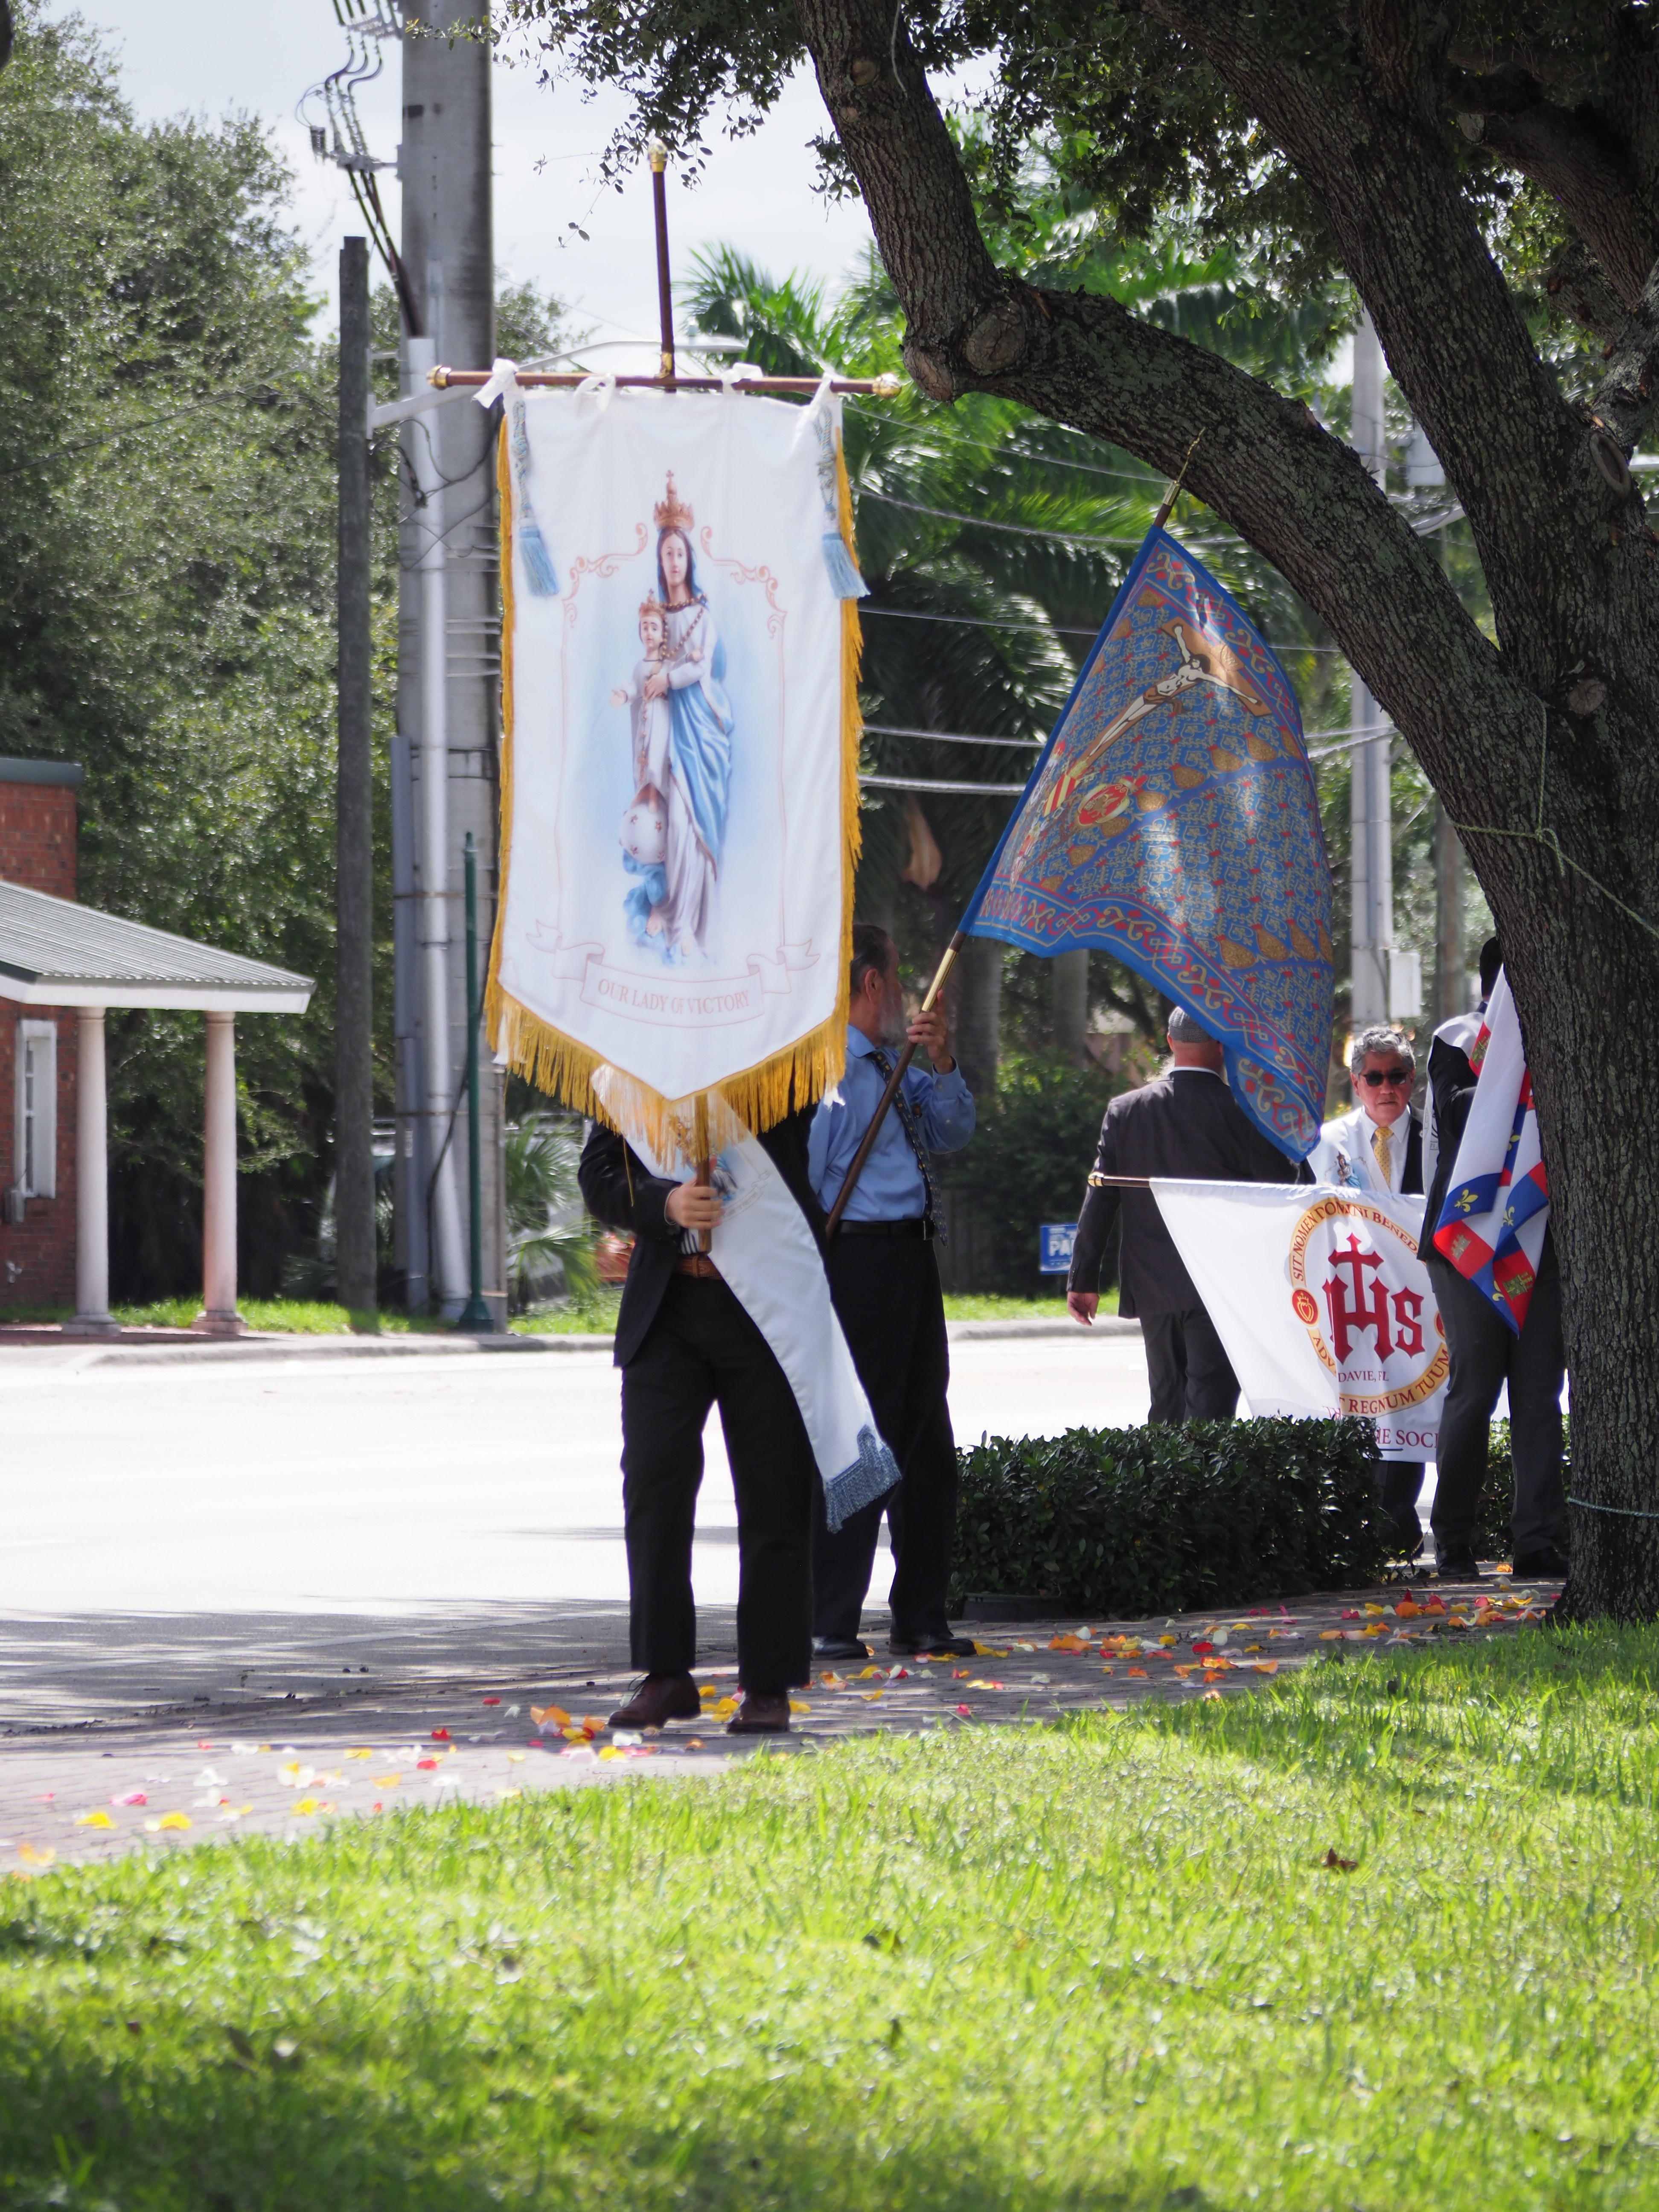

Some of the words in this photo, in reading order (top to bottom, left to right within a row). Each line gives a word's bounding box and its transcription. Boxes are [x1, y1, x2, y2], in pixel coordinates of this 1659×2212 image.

[598, 978, 628, 1003] OUR
[632, 990, 669, 1012] LADY
[671, 997, 684, 1014] OF
[687, 990, 749, 1015] VICTORY
[1314, 1202, 1368, 1220] DOMINI
[1293, 1212, 1318, 1256] NOMEN
[1293, 1255, 1304, 1281] SIT
[1338, 1371, 1376, 1382] DAVIE,
[1379, 1371, 1389, 1381] FL
[1348, 1389, 1416, 1414] REGNUM
[1415, 1348, 1449, 1396] TUUM
